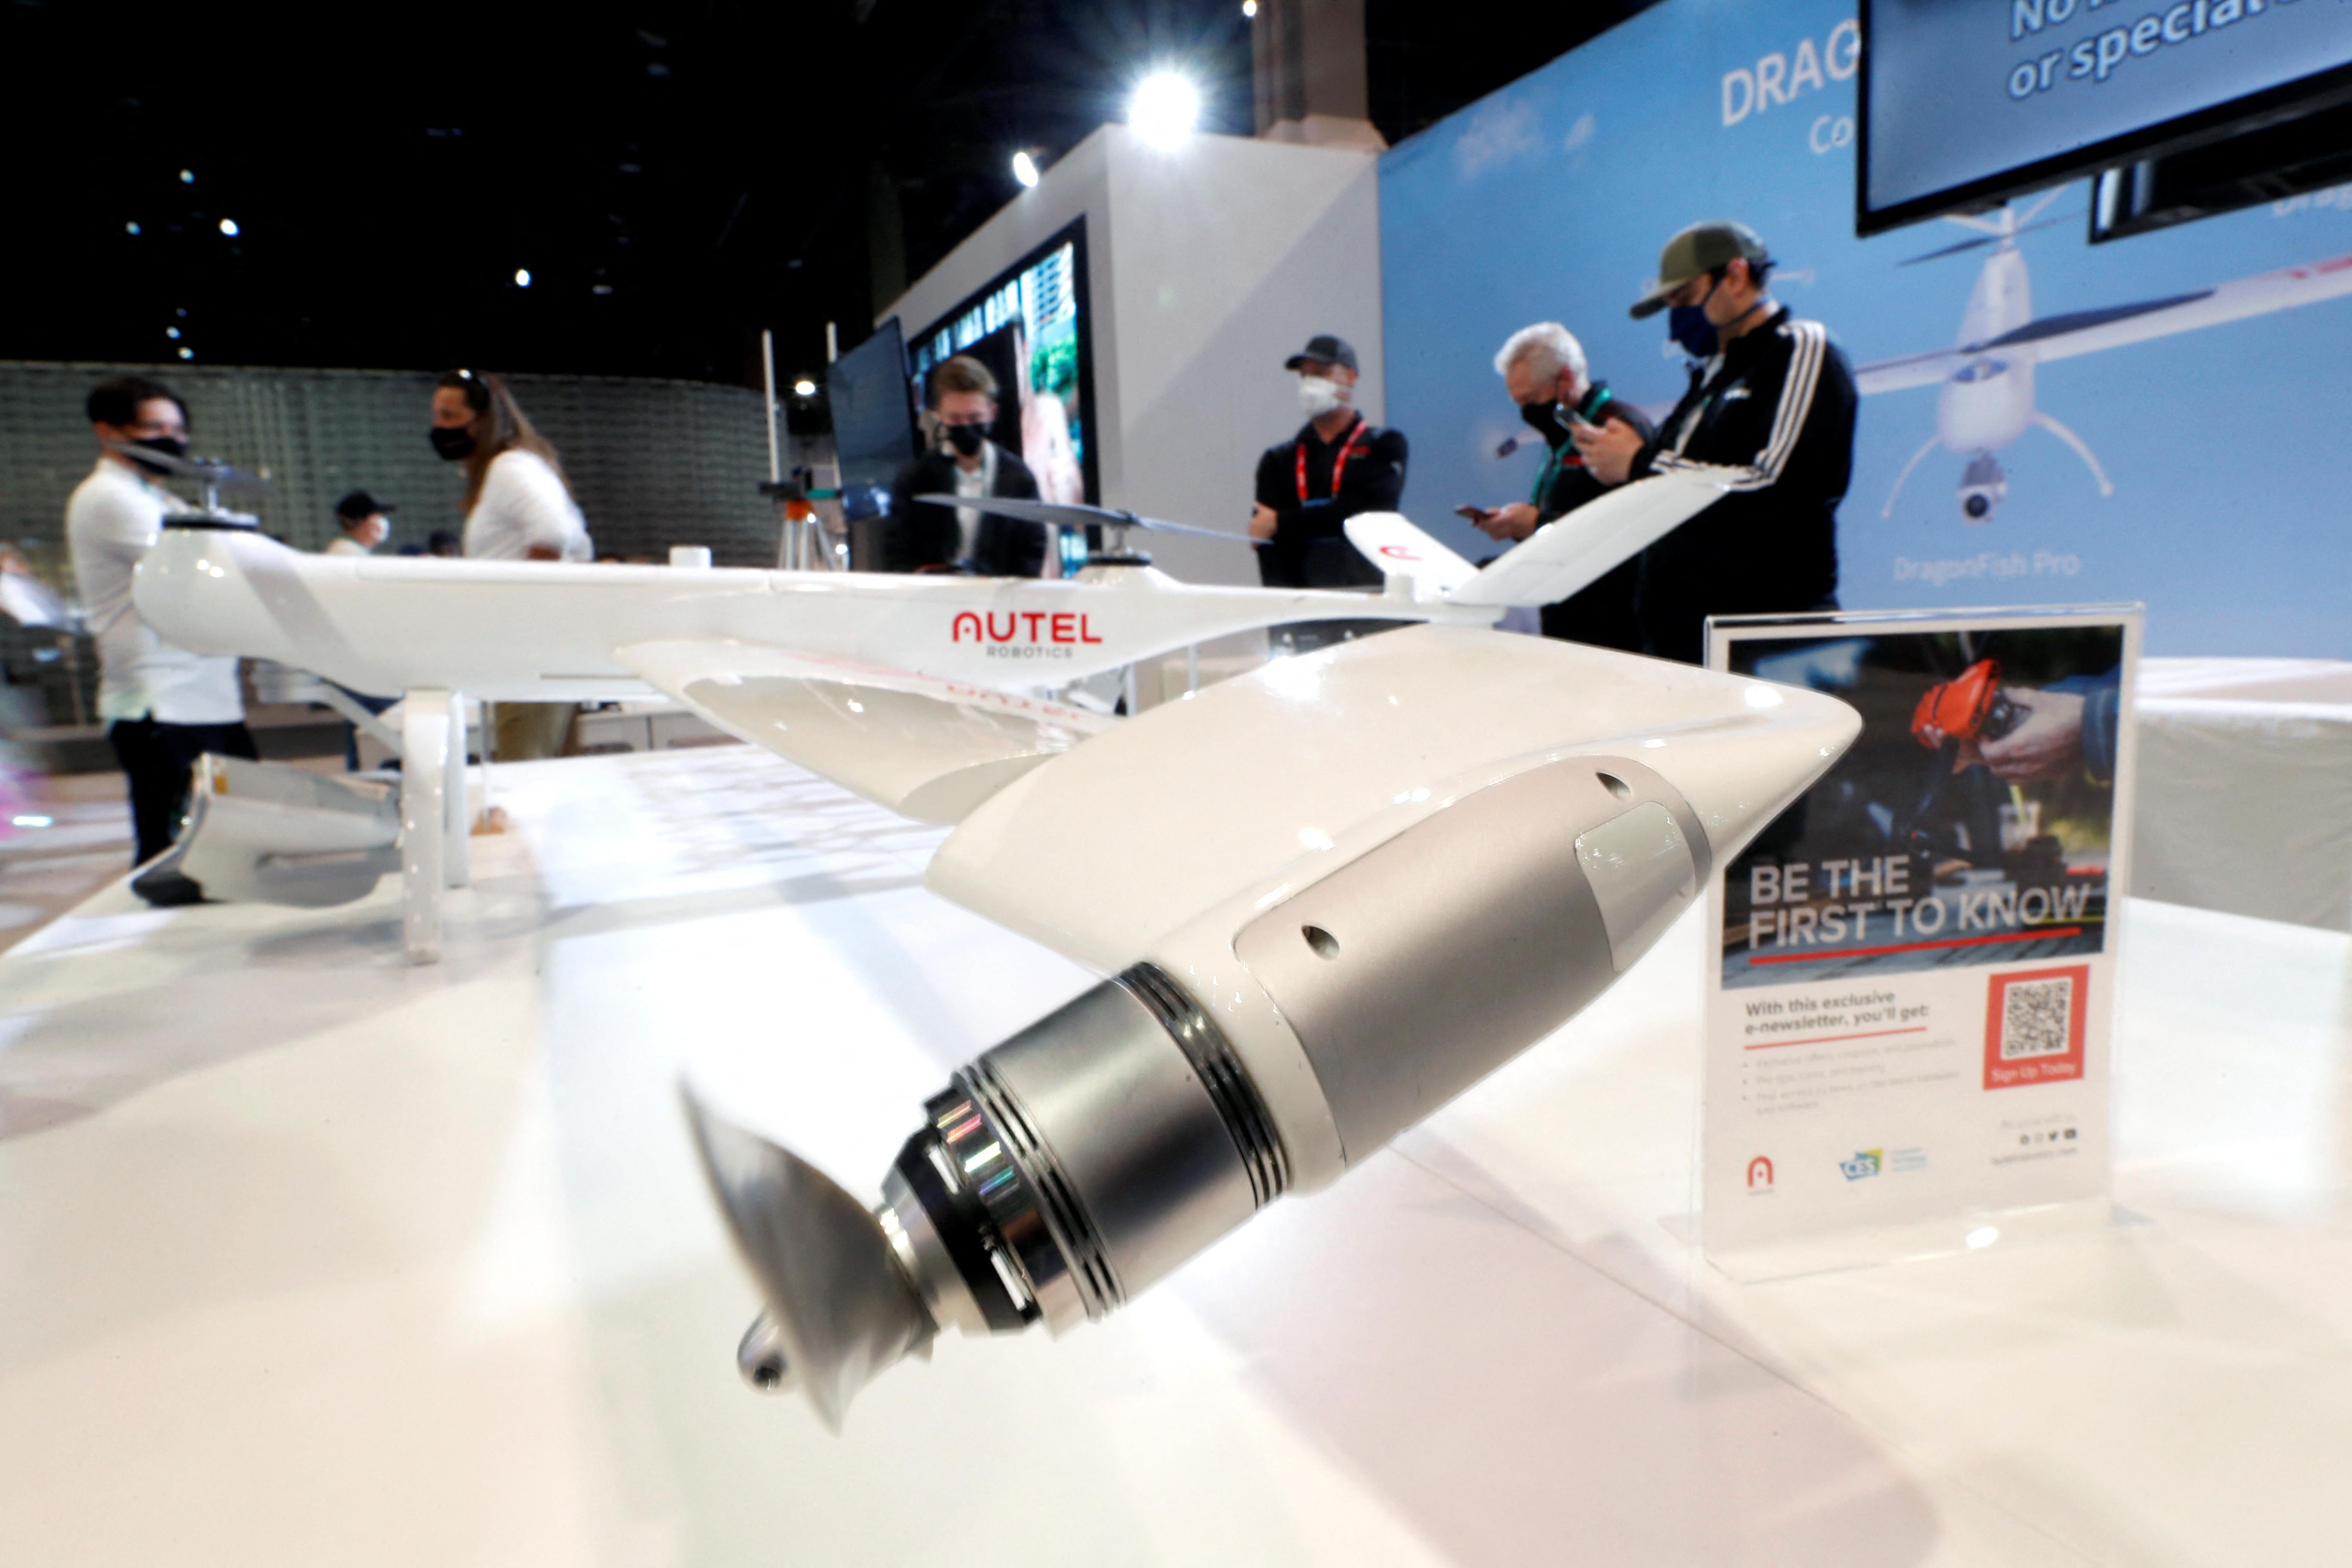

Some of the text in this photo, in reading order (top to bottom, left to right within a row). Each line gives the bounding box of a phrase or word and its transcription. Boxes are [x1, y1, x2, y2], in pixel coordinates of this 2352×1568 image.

[2009, 50, 2061, 98] or
[952, 610, 1102, 643] AUTEL
[986, 646, 1073, 658] ROBOTICS
[1751, 854, 1909, 905] BE THE
[1749, 883, 2092, 949] FIRST TO KNOW
[1746, 990, 1896, 1017] With this exclusive
[1745, 1014, 1849, 1035] e-newsletter,
